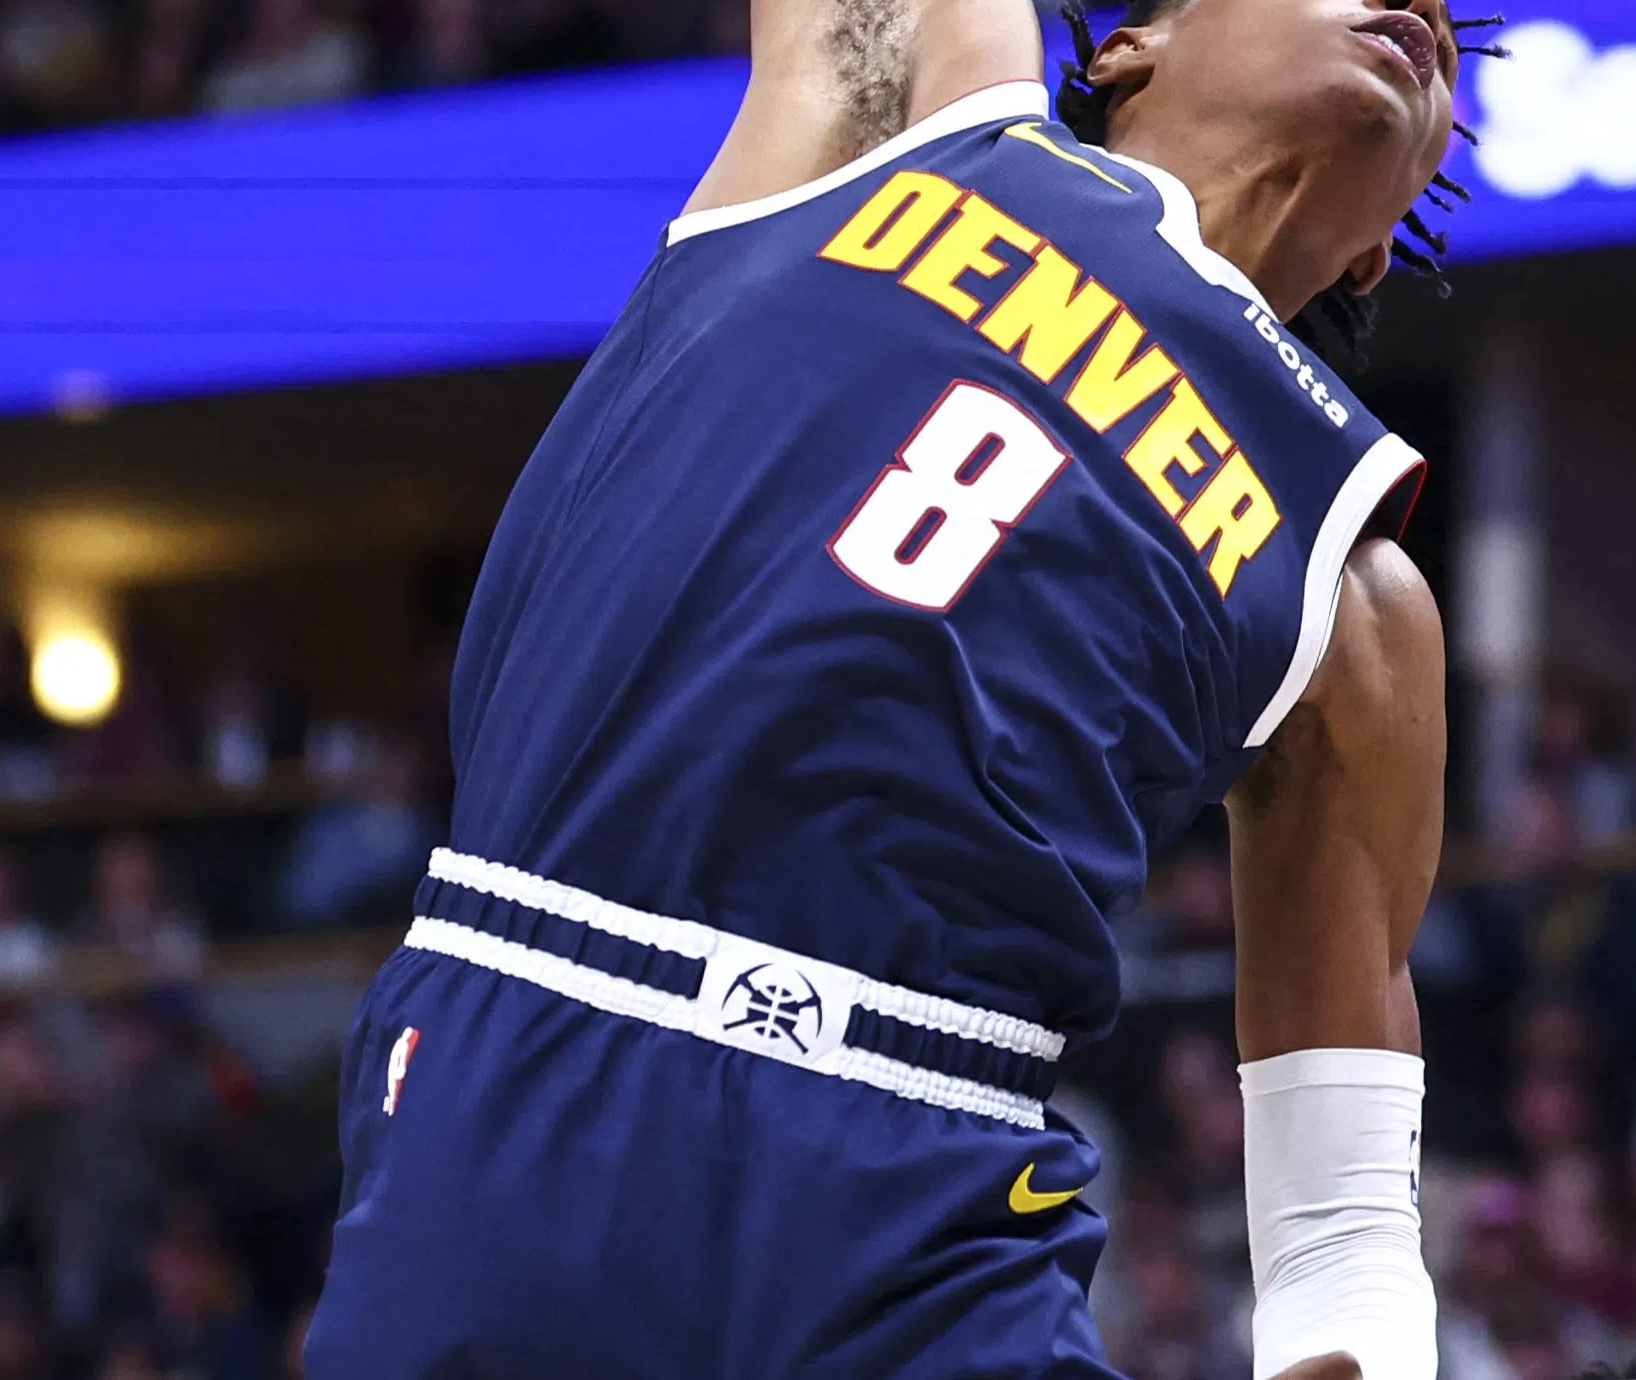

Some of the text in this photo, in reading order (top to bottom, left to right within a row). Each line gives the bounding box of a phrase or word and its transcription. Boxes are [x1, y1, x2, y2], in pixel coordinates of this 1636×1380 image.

[816, 170, 1283, 602] DENVER
[1243, 303, 1349, 428] ibotta
[825, 378, 1073, 612] 8
